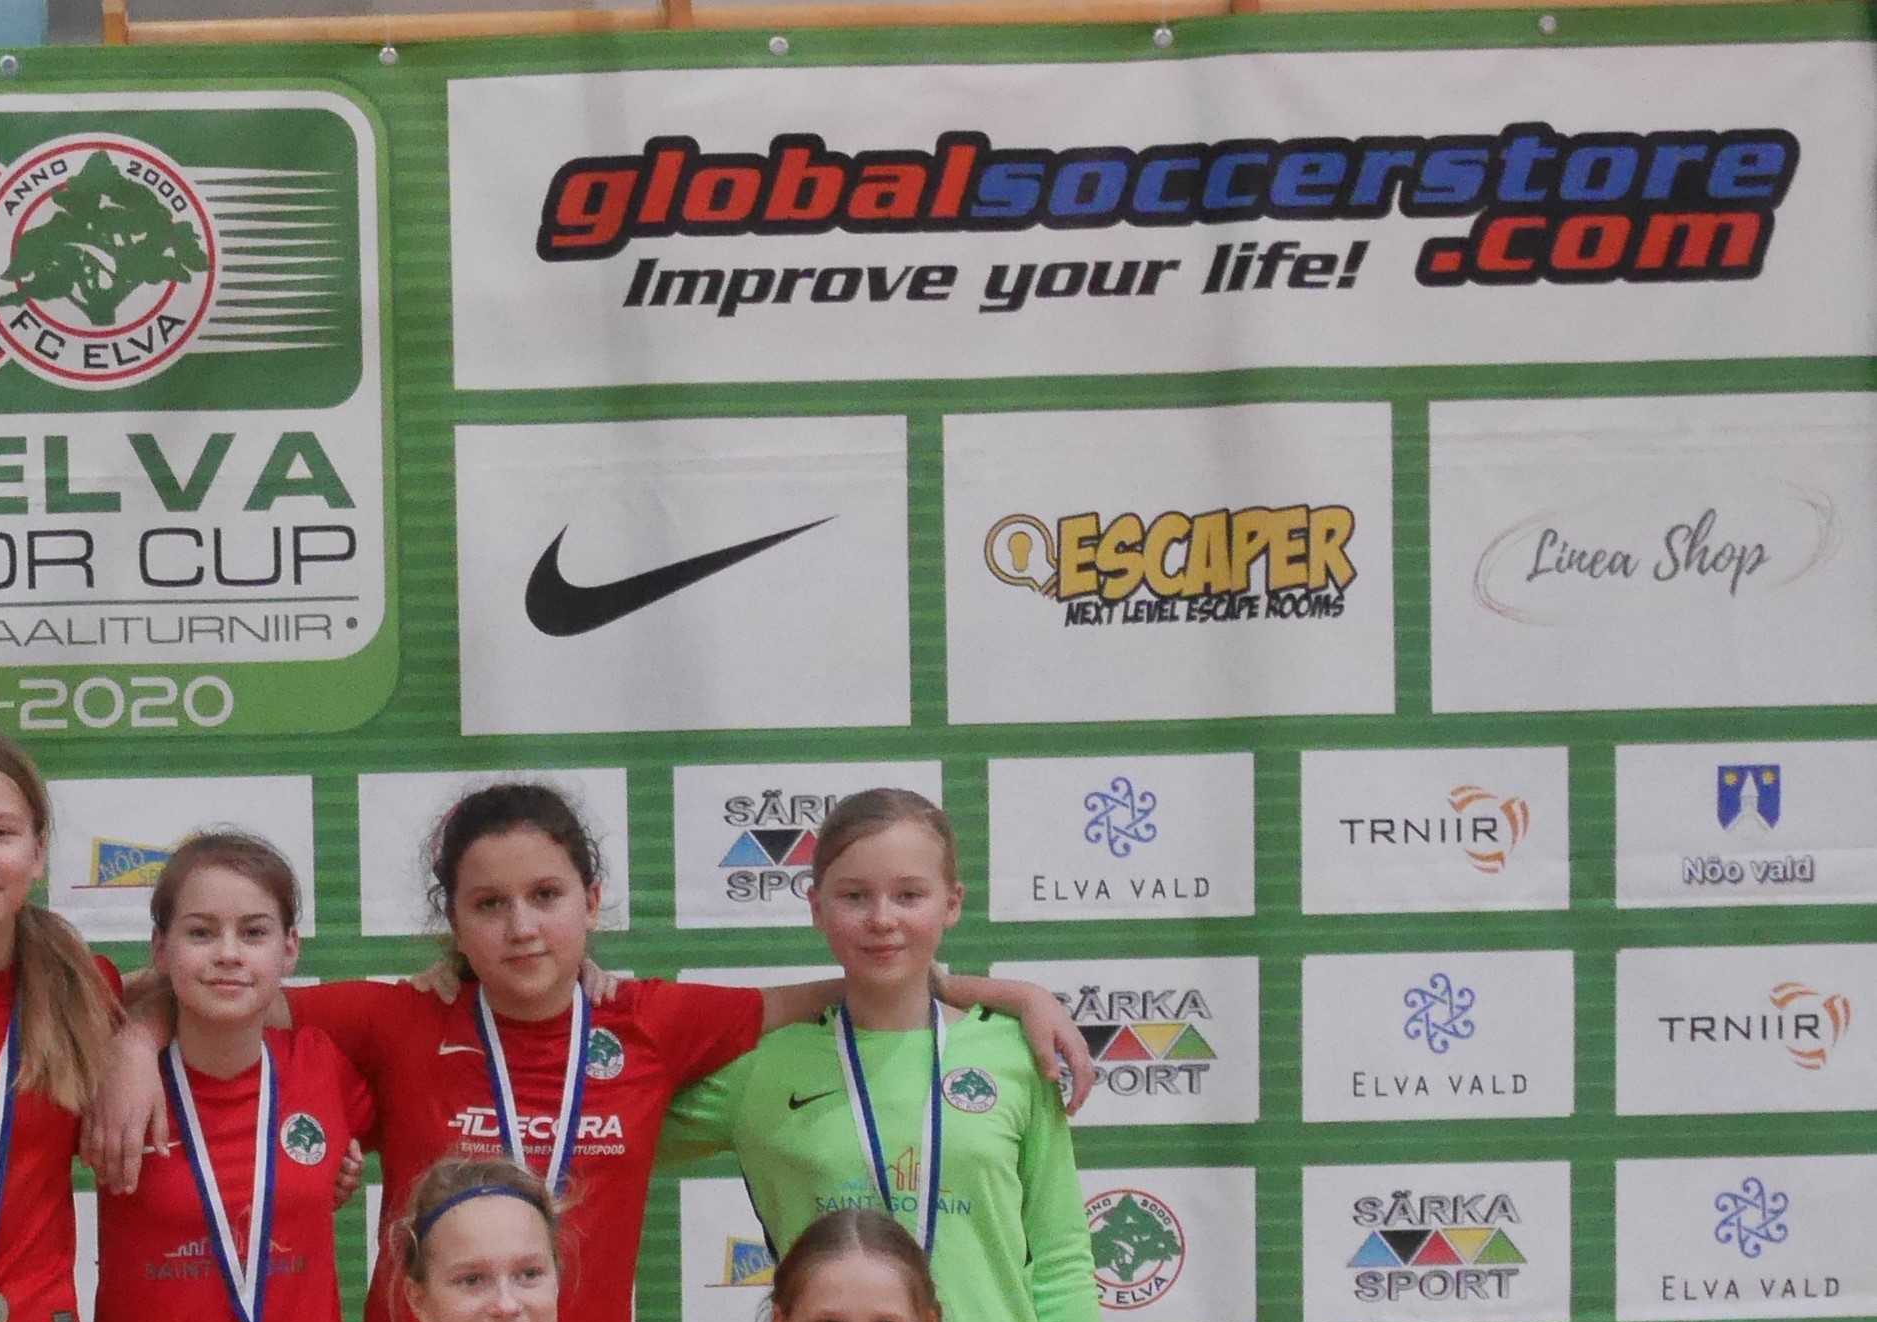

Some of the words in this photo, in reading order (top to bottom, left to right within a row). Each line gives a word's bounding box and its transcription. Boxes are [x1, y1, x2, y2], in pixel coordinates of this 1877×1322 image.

[4, 159, 67, 216] ANNO
[126, 160, 188, 213] 2000
[536, 121, 1800, 262] globalsoccerstore
[1415, 209, 1775, 286] .com
[622, 258, 957, 317] Improve
[979, 257, 1180, 313] your
[1201, 240, 1371, 294] life!
[10, 310, 66, 360] FC
[84, 314, 186, 369] ELVA
[138, 525, 357, 588] CUP
[1057, 503, 1357, 602] ESCAPER
[1526, 529, 1640, 583] Linea
[1653, 508, 1770, 598] Shop
[1065, 600, 1117, 627] NEXT
[1122, 599, 1179, 625] LEVEL
[1186, 597, 1260, 623] ESCAPE
[1265, 593, 1346, 620] ROOMS
[724, 789, 836, 827] SÄR
[1340, 816, 1499, 845] TRNIIR
[727, 870, 815, 902] SPO
[1682, 856, 1743, 884] Nõo
[1750, 855, 1814, 884] vald
[1033, 876, 1111, 901] ELVA
[1132, 875, 1210, 899] VALD
[1658, 1013, 1821, 1042] TRNIIR
[1352, 1072, 1430, 1098] ELVA
[1448, 1073, 1528, 1096] VALD
[448, 1106, 623, 1139] DECRA
[573, 1143, 625, 1156] ITUSPOOD
[815, 1195, 971, 1216] SAINT-GOAIN
[1085, 1198, 1111, 1217] NNO
[1353, 1190, 1522, 1228] SÄRKA
[1116, 1276, 1169, 1305] ELVA
[1353, 1267, 1521, 1302] SPORT
[1661, 1275, 1740, 1302] ELVA
[1761, 1276, 1840, 1299] VALD
